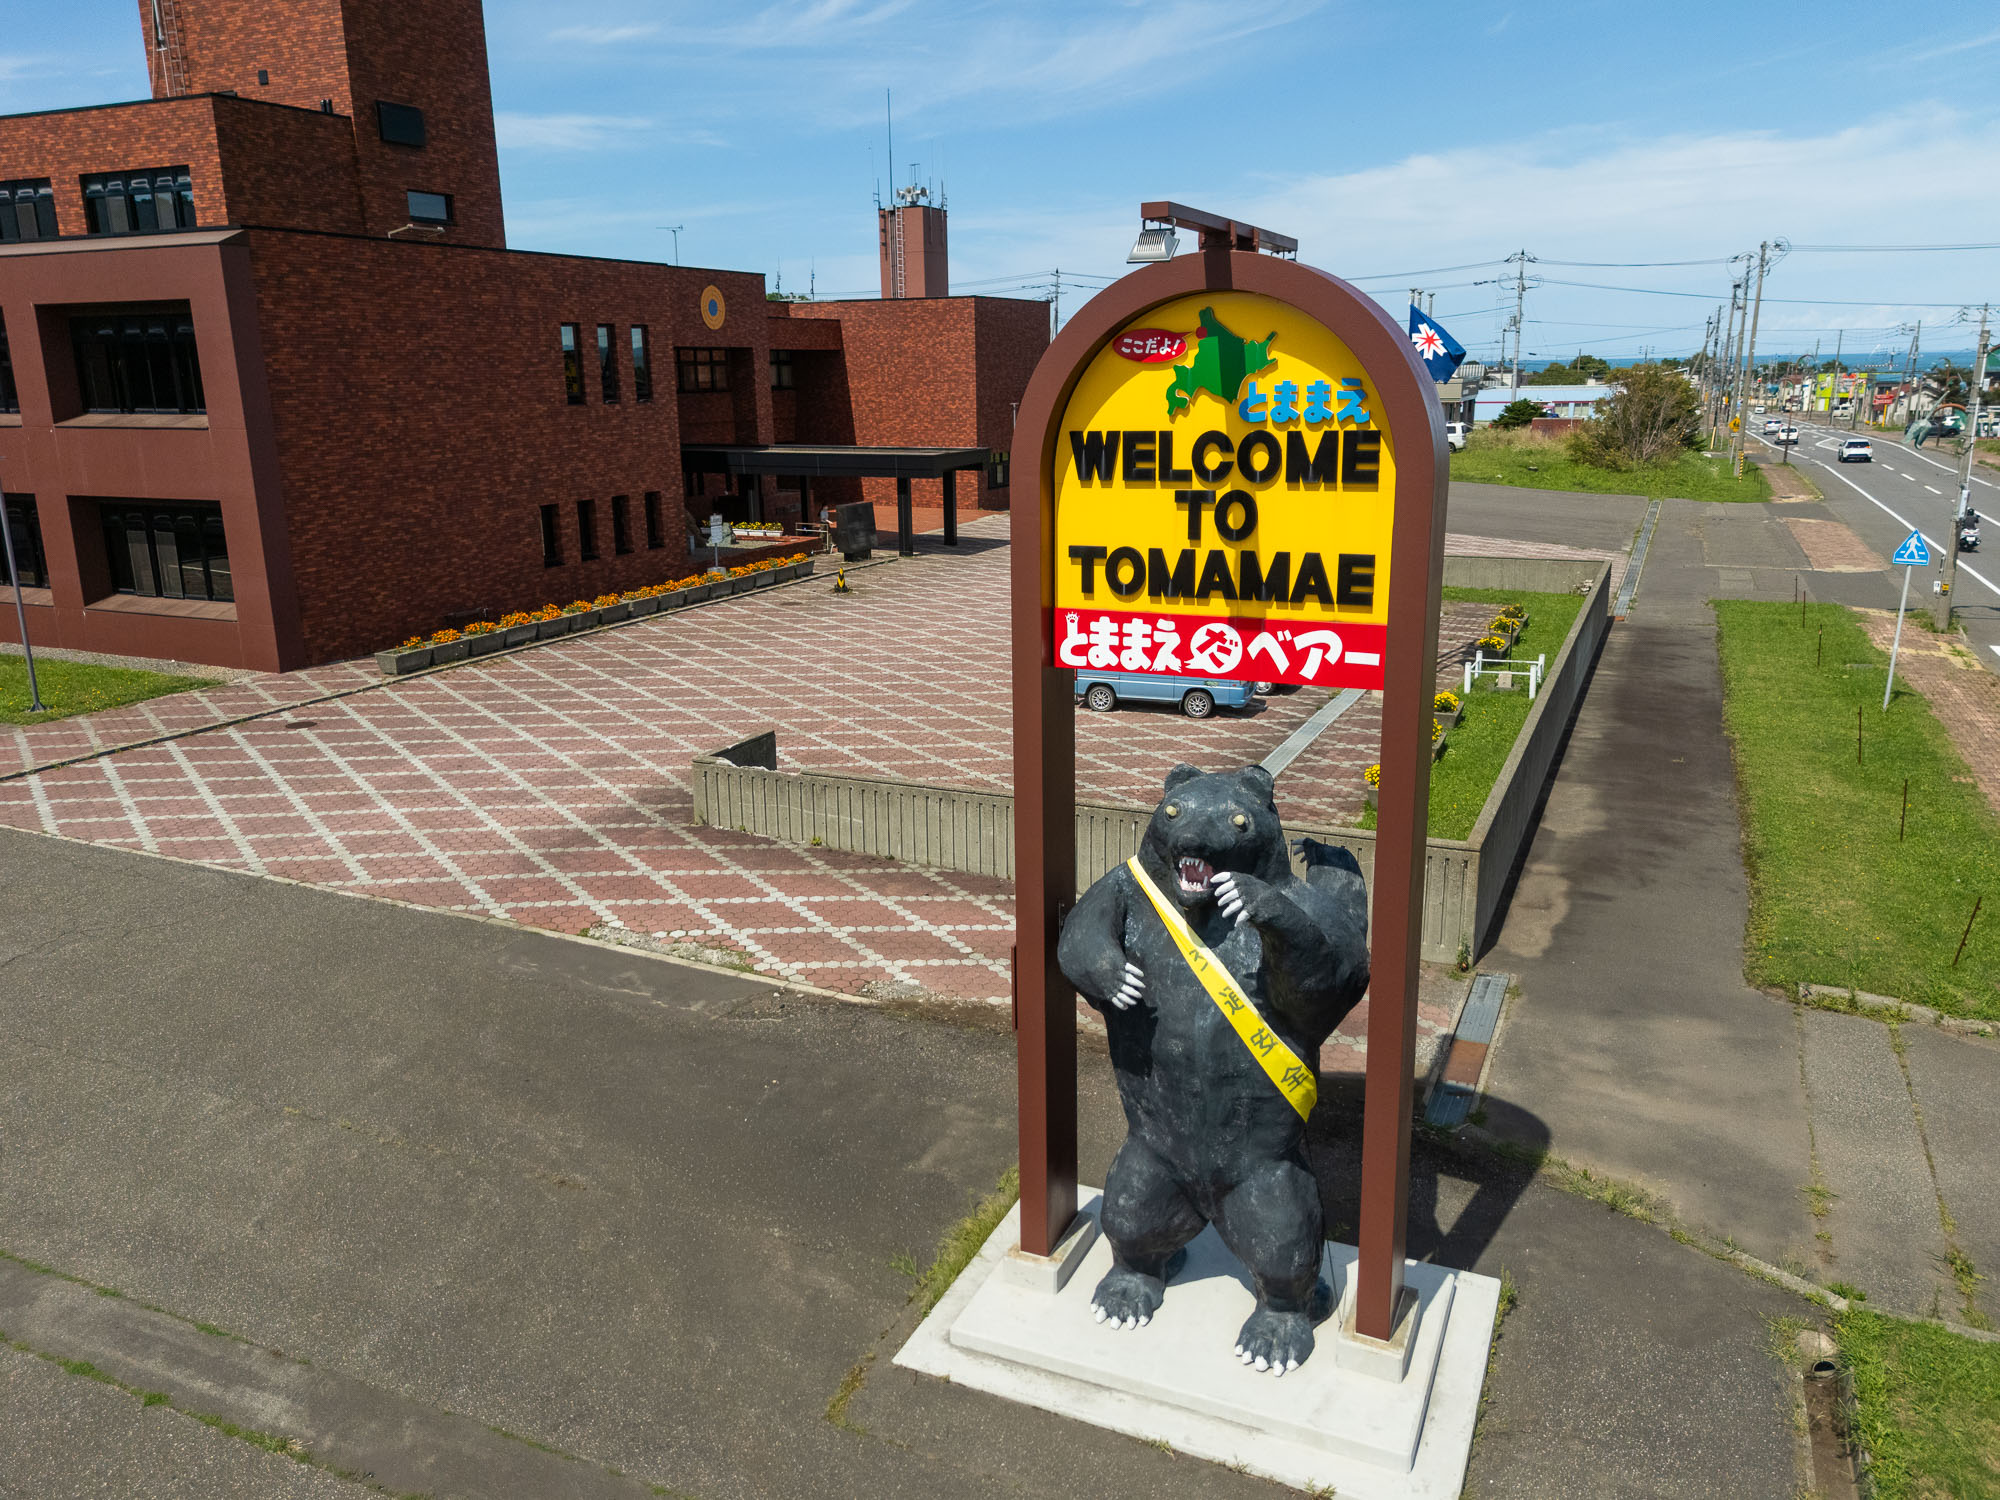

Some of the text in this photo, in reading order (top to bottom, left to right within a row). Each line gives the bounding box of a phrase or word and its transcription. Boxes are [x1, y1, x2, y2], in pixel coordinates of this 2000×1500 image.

[1239, 378, 1370, 424] とままえ
[1069, 430, 1381, 484] WELCOME
[1174, 489, 1258, 542] TO
[1068, 545, 1376, 606] TOMAMAE
